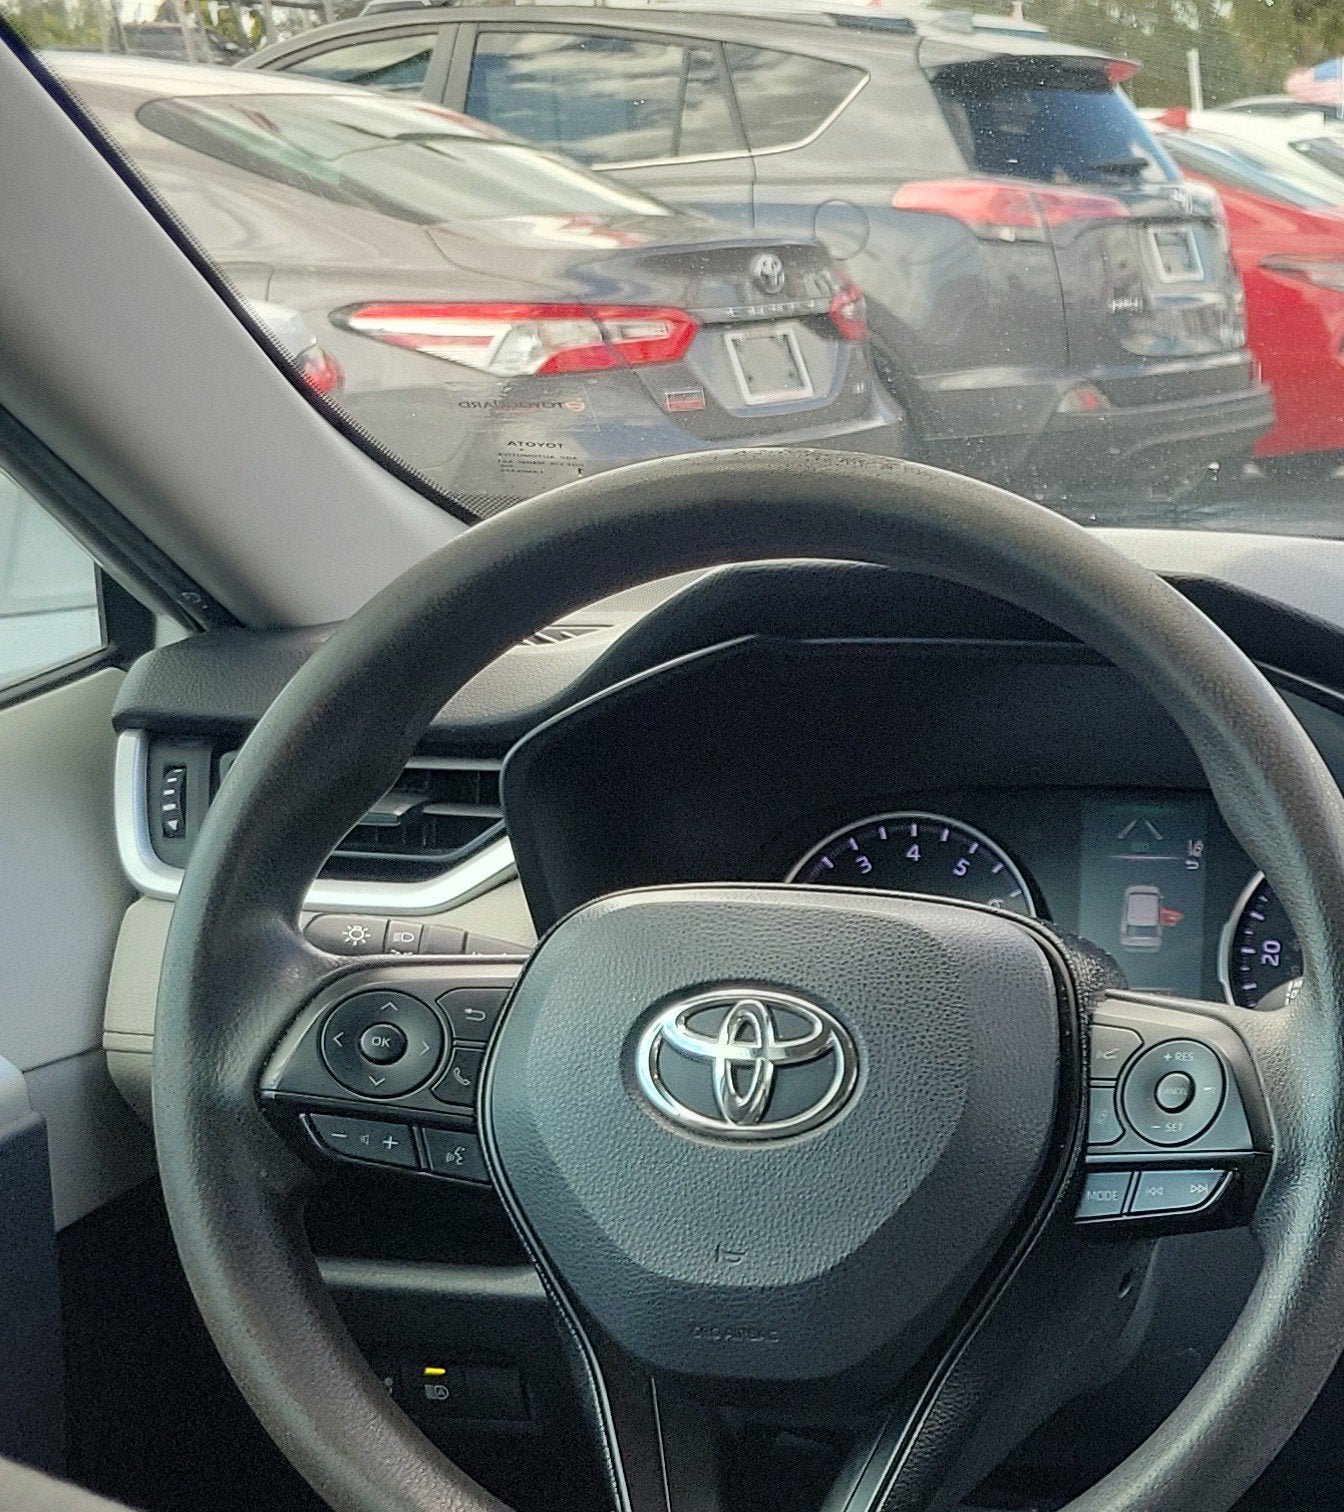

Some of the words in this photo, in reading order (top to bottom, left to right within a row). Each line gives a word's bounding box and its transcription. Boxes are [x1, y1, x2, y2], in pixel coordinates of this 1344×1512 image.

[906, 844, 921, 862] 4
[856, 856, 873, 874] 3
[953, 858, 970, 876] 5
[1262, 940, 1281, 968] 20
[371, 1036, 391, 1048] OK
[1175, 1052, 1194, 1062] RES
[1165, 1122, 1184, 1132] SET
[1087, 1190, 1118, 1201] MODE
